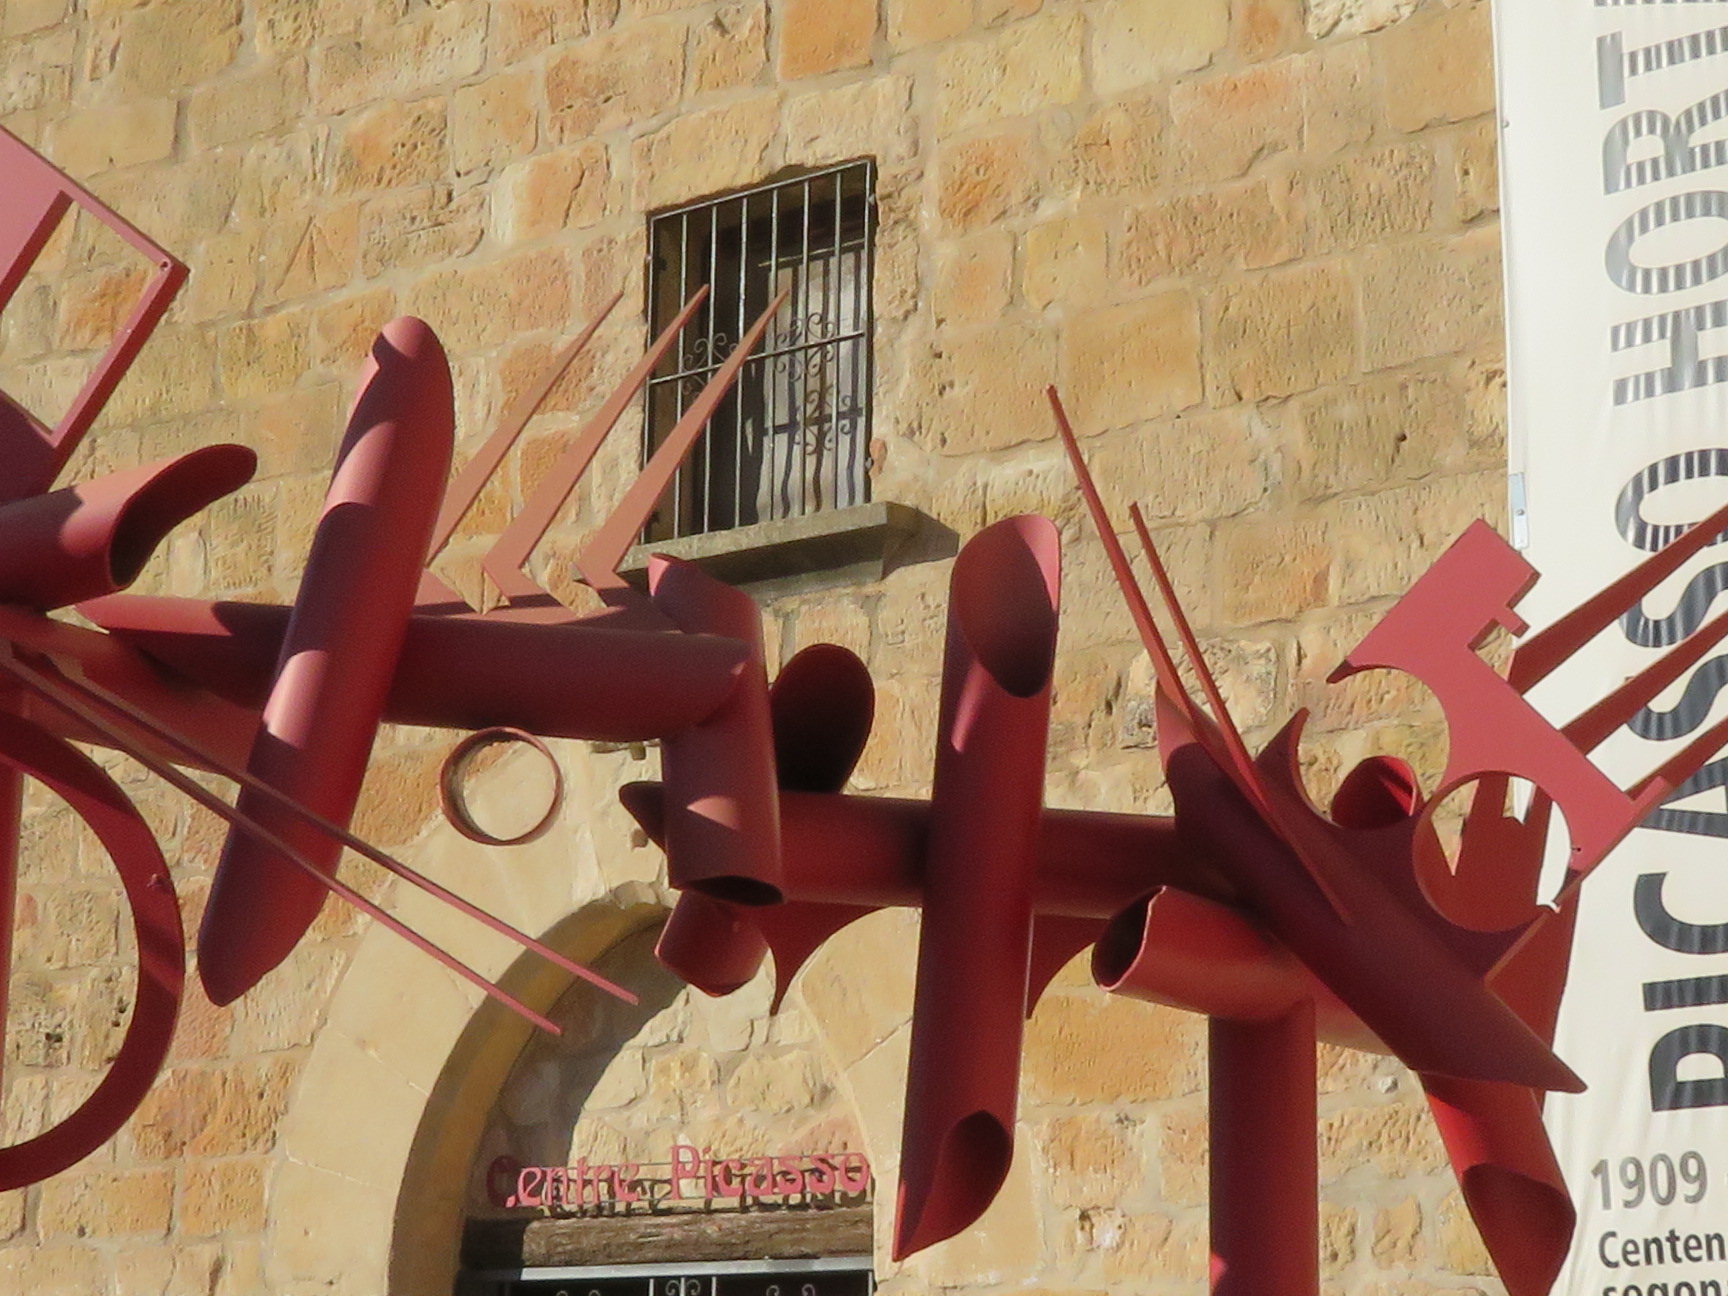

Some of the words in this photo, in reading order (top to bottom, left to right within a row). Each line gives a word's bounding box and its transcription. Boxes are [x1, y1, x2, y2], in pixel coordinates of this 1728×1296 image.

[487, 1156, 639, 1208] Centre
[672, 1145, 872, 1200] Picasso
[1591, 1151, 1708, 1210] 1909
